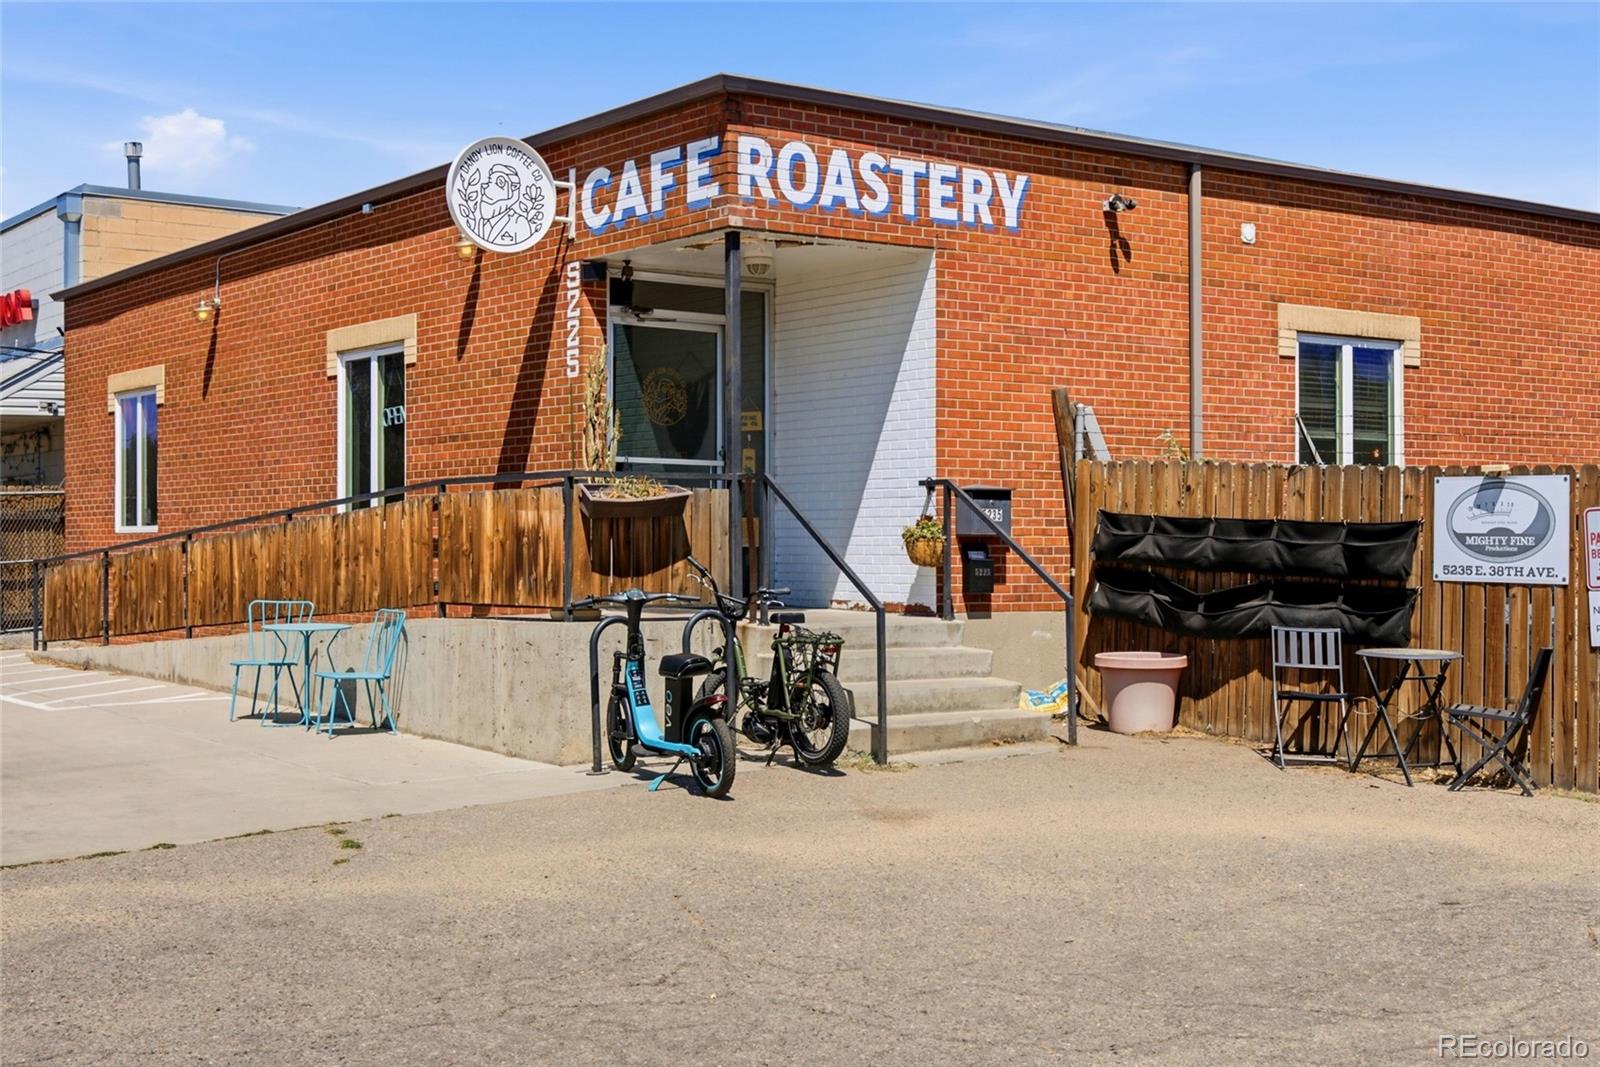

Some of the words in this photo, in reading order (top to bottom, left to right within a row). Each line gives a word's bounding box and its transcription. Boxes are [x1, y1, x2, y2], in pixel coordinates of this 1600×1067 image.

[460, 148, 482, 174] DANDY
[484, 143, 503, 156] LION
[506, 145, 534, 169] COFFEE
[581, 136, 721, 235] CAFE
[737, 135, 1029, 232] ROASTERY
[567, 261, 580, 378] 5225
[1442, 564, 1474, 576] 5235
[1475, 565, 1487, 577] E.
[1488, 565, 1525, 578] 38TH
[1525, 566, 1559, 579] AVE.
[1465, 535, 1508, 545] MIGHTY
[1509, 536, 1536, 547] FINE
